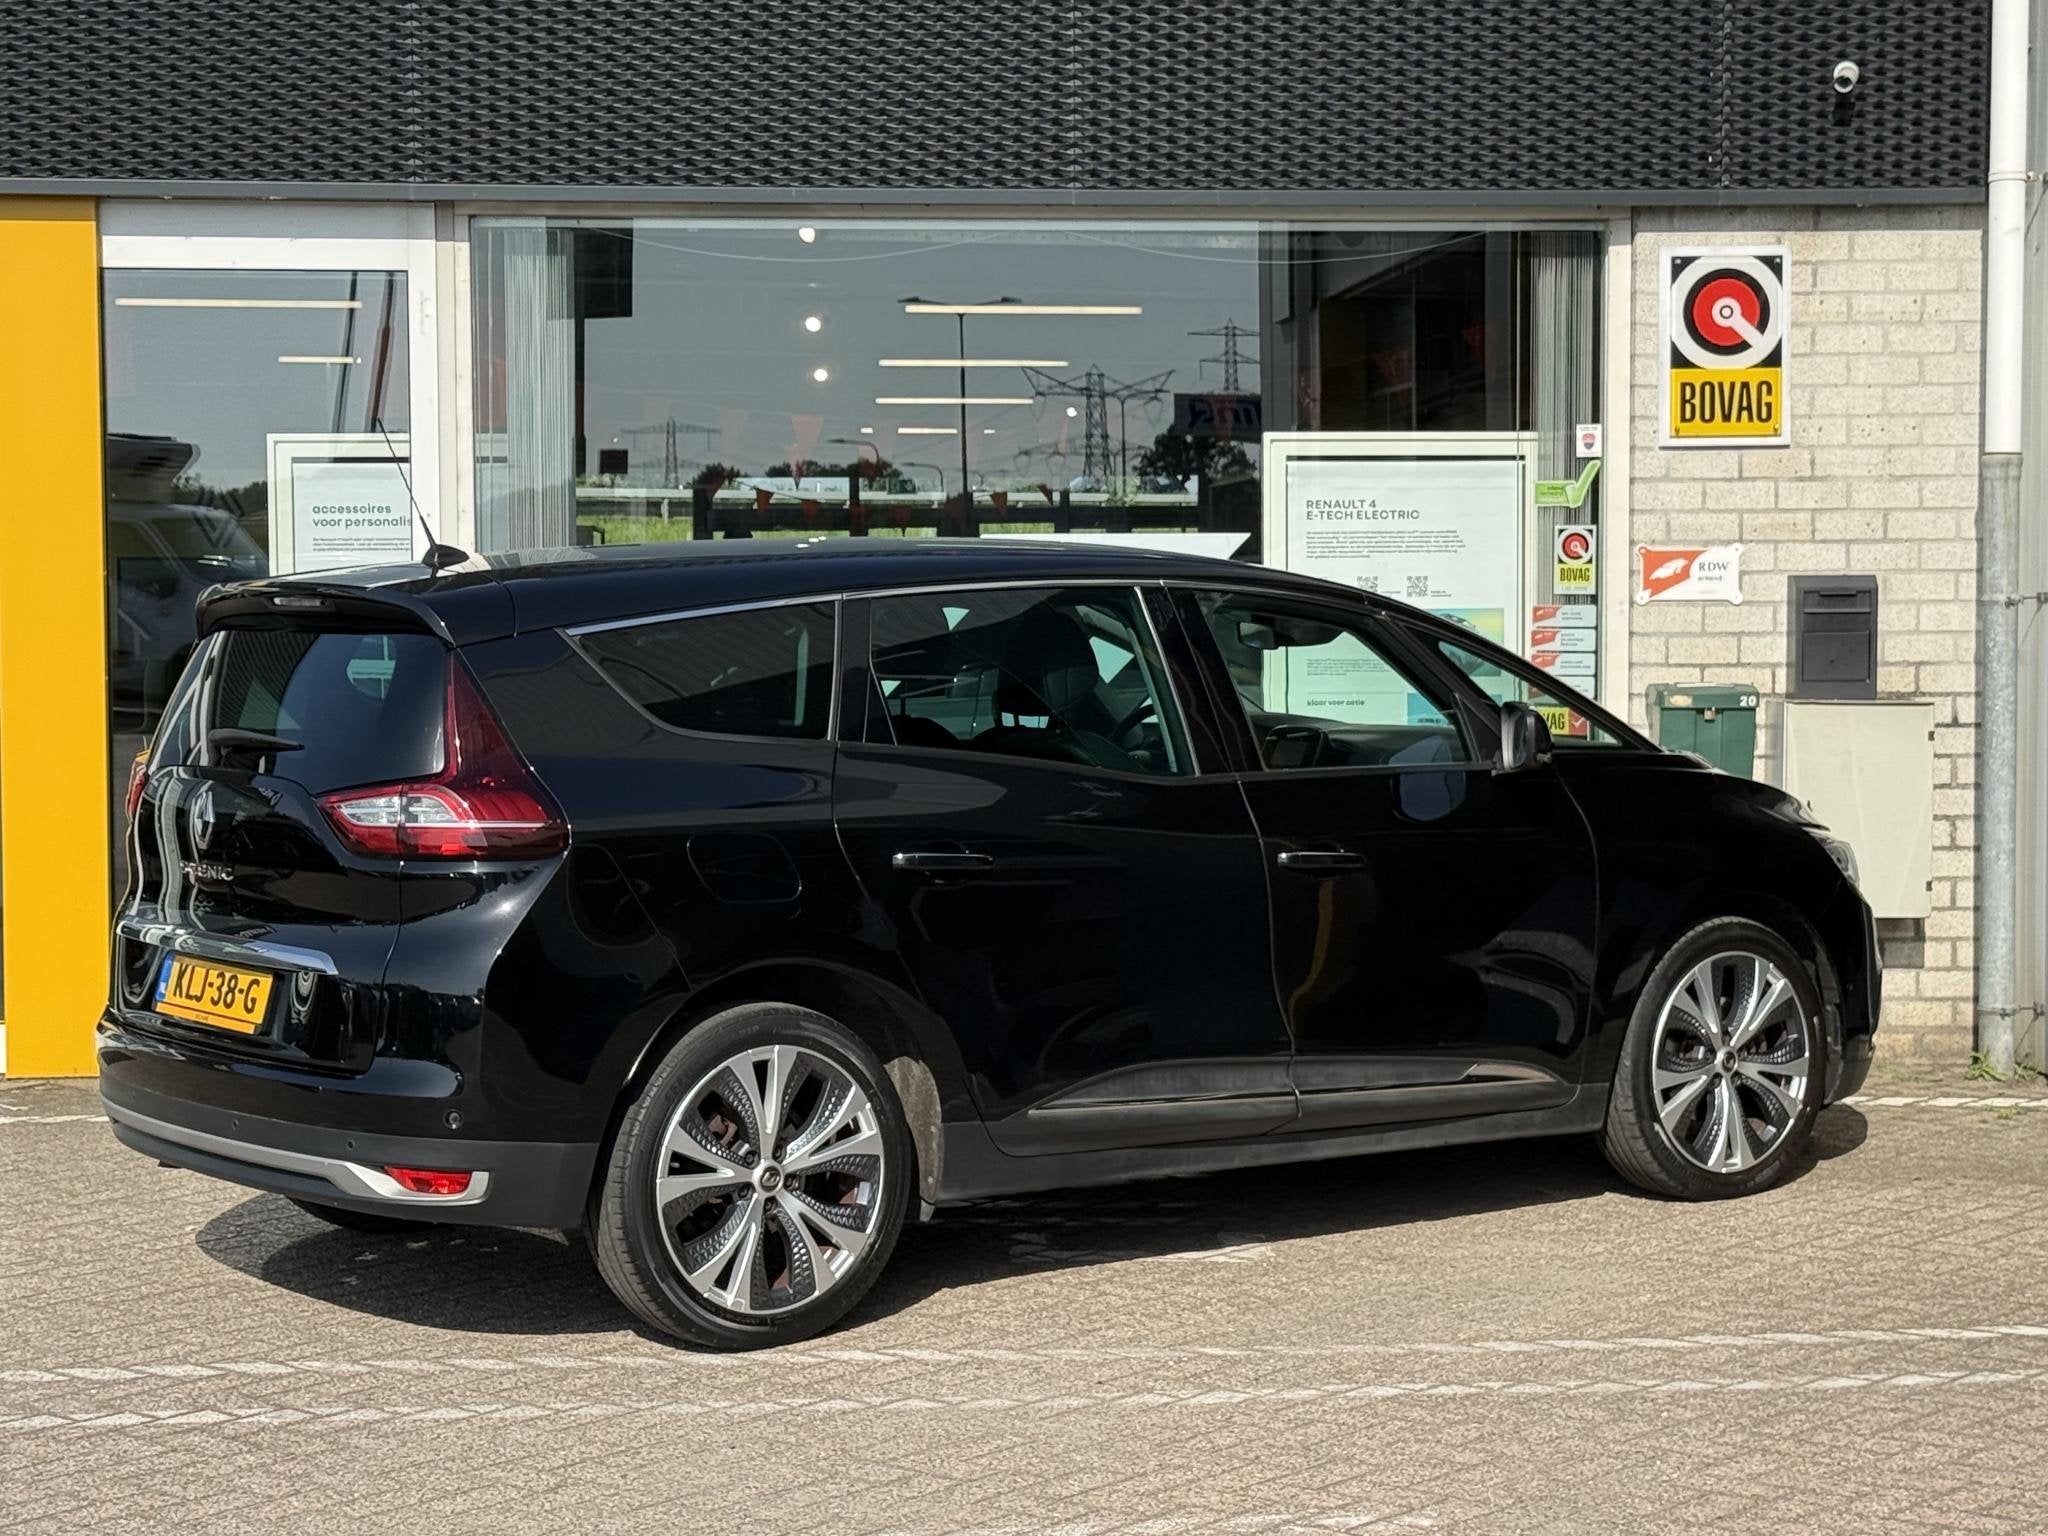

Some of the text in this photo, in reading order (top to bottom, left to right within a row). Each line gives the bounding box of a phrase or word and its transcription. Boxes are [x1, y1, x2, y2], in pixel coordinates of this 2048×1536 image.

[1680, 380, 1773, 424] BOVAG
[312, 502, 392, 515] accessoires
[1306, 499, 1377, 510] RENAULT 4
[1306, 509, 1421, 521] E-TECH ELECTRIC
[312, 517, 342, 528] voor
[1698, 561, 1730, 572] RDW
[1559, 567, 1590, 582] BOVAG
[1739, 695, 1757, 707] 20
[1542, 712, 1565, 731] VAG
[173, 962, 261, 1015] KLJ-38-G
